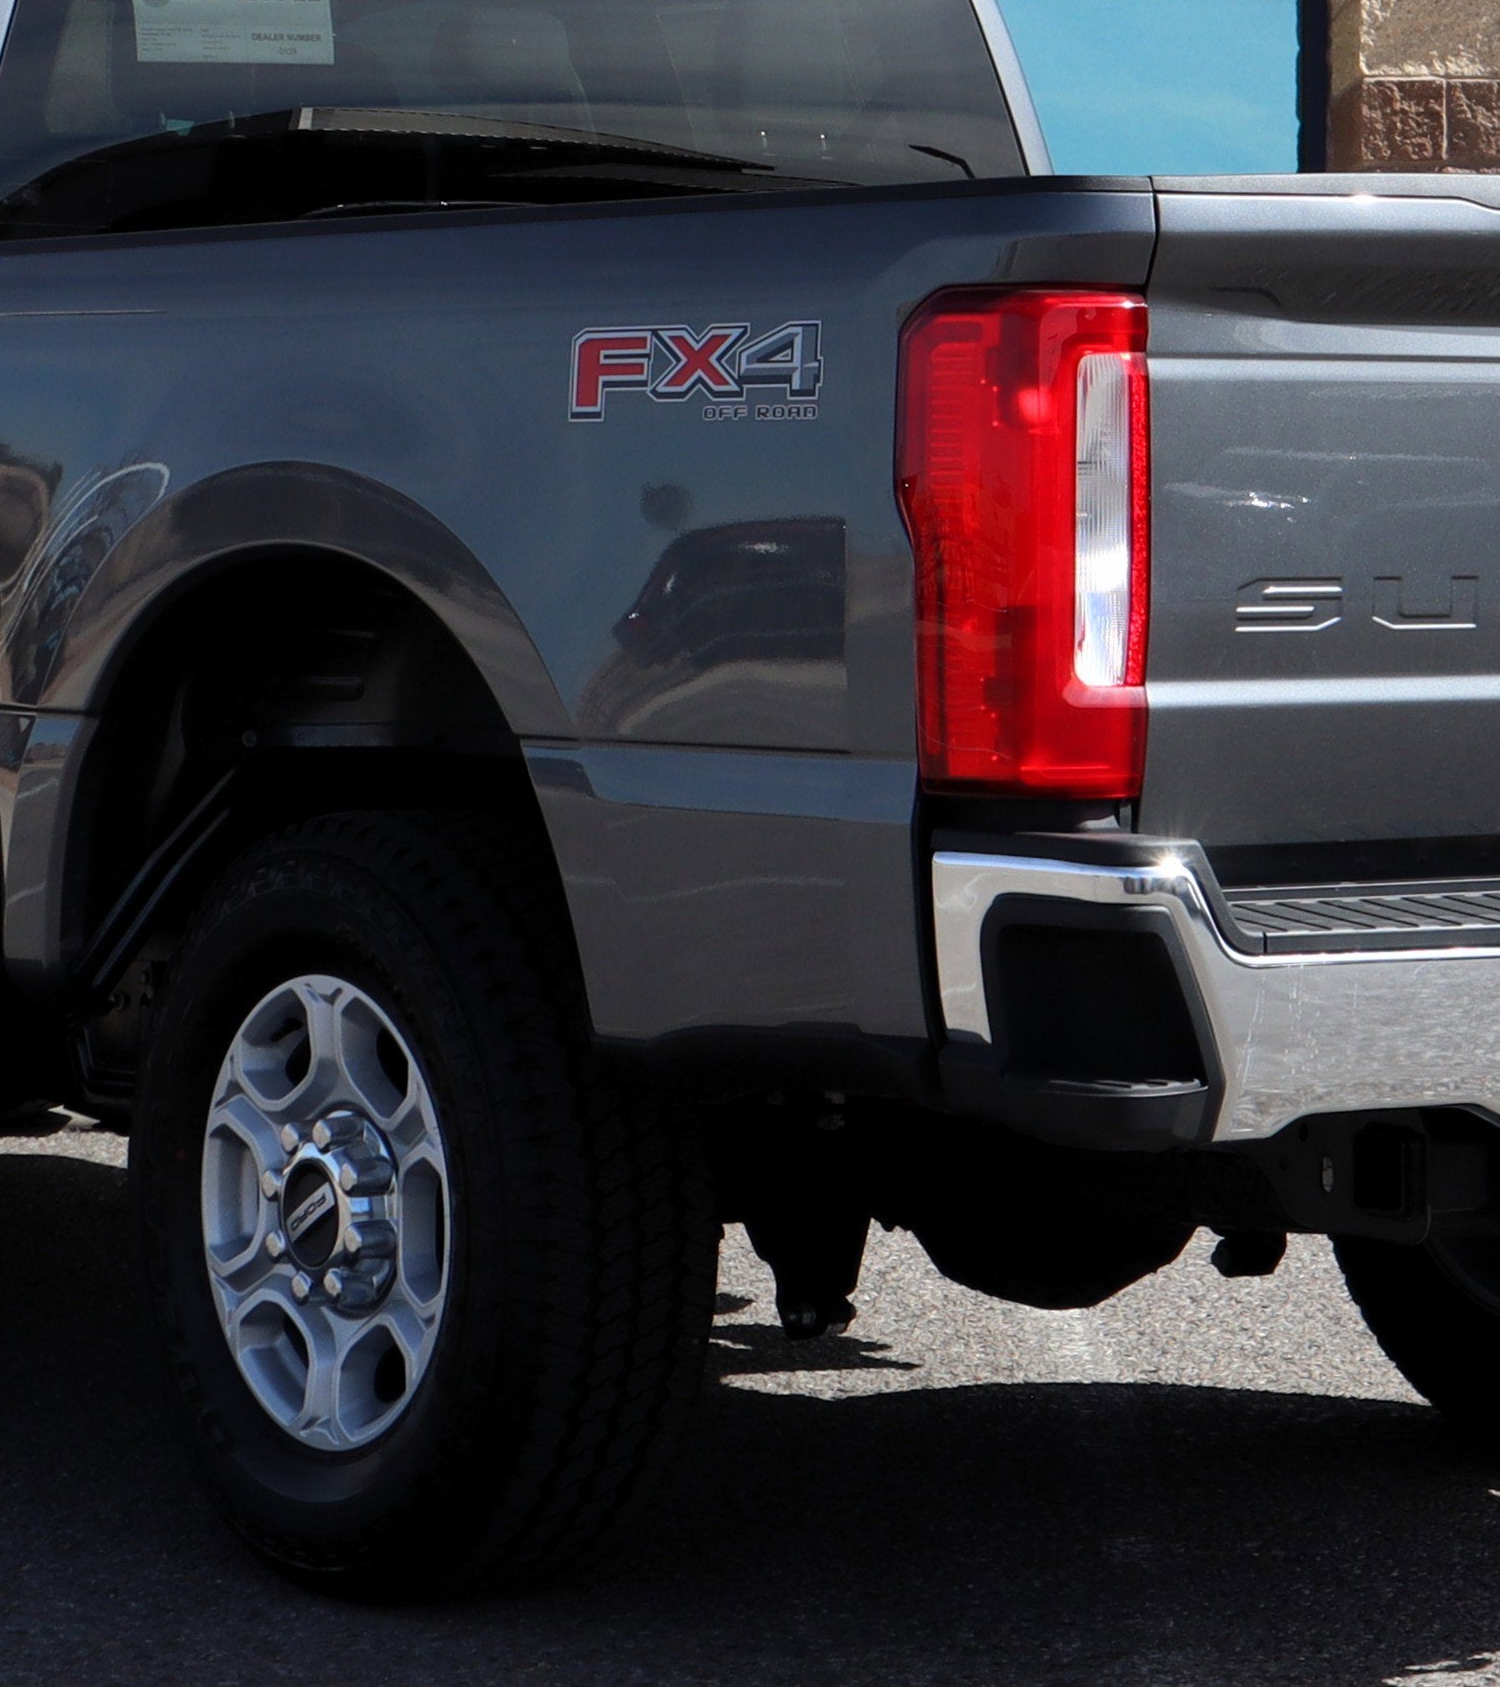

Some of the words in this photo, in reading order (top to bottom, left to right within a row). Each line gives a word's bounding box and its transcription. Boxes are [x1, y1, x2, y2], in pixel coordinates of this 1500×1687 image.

[252, 33, 285, 41] DEALER
[287, 34, 322, 42] NUMBER
[569, 320, 823, 422] FX4
[703, 404, 749, 420] OFF
[755, 404, 819, 420] ROAD
